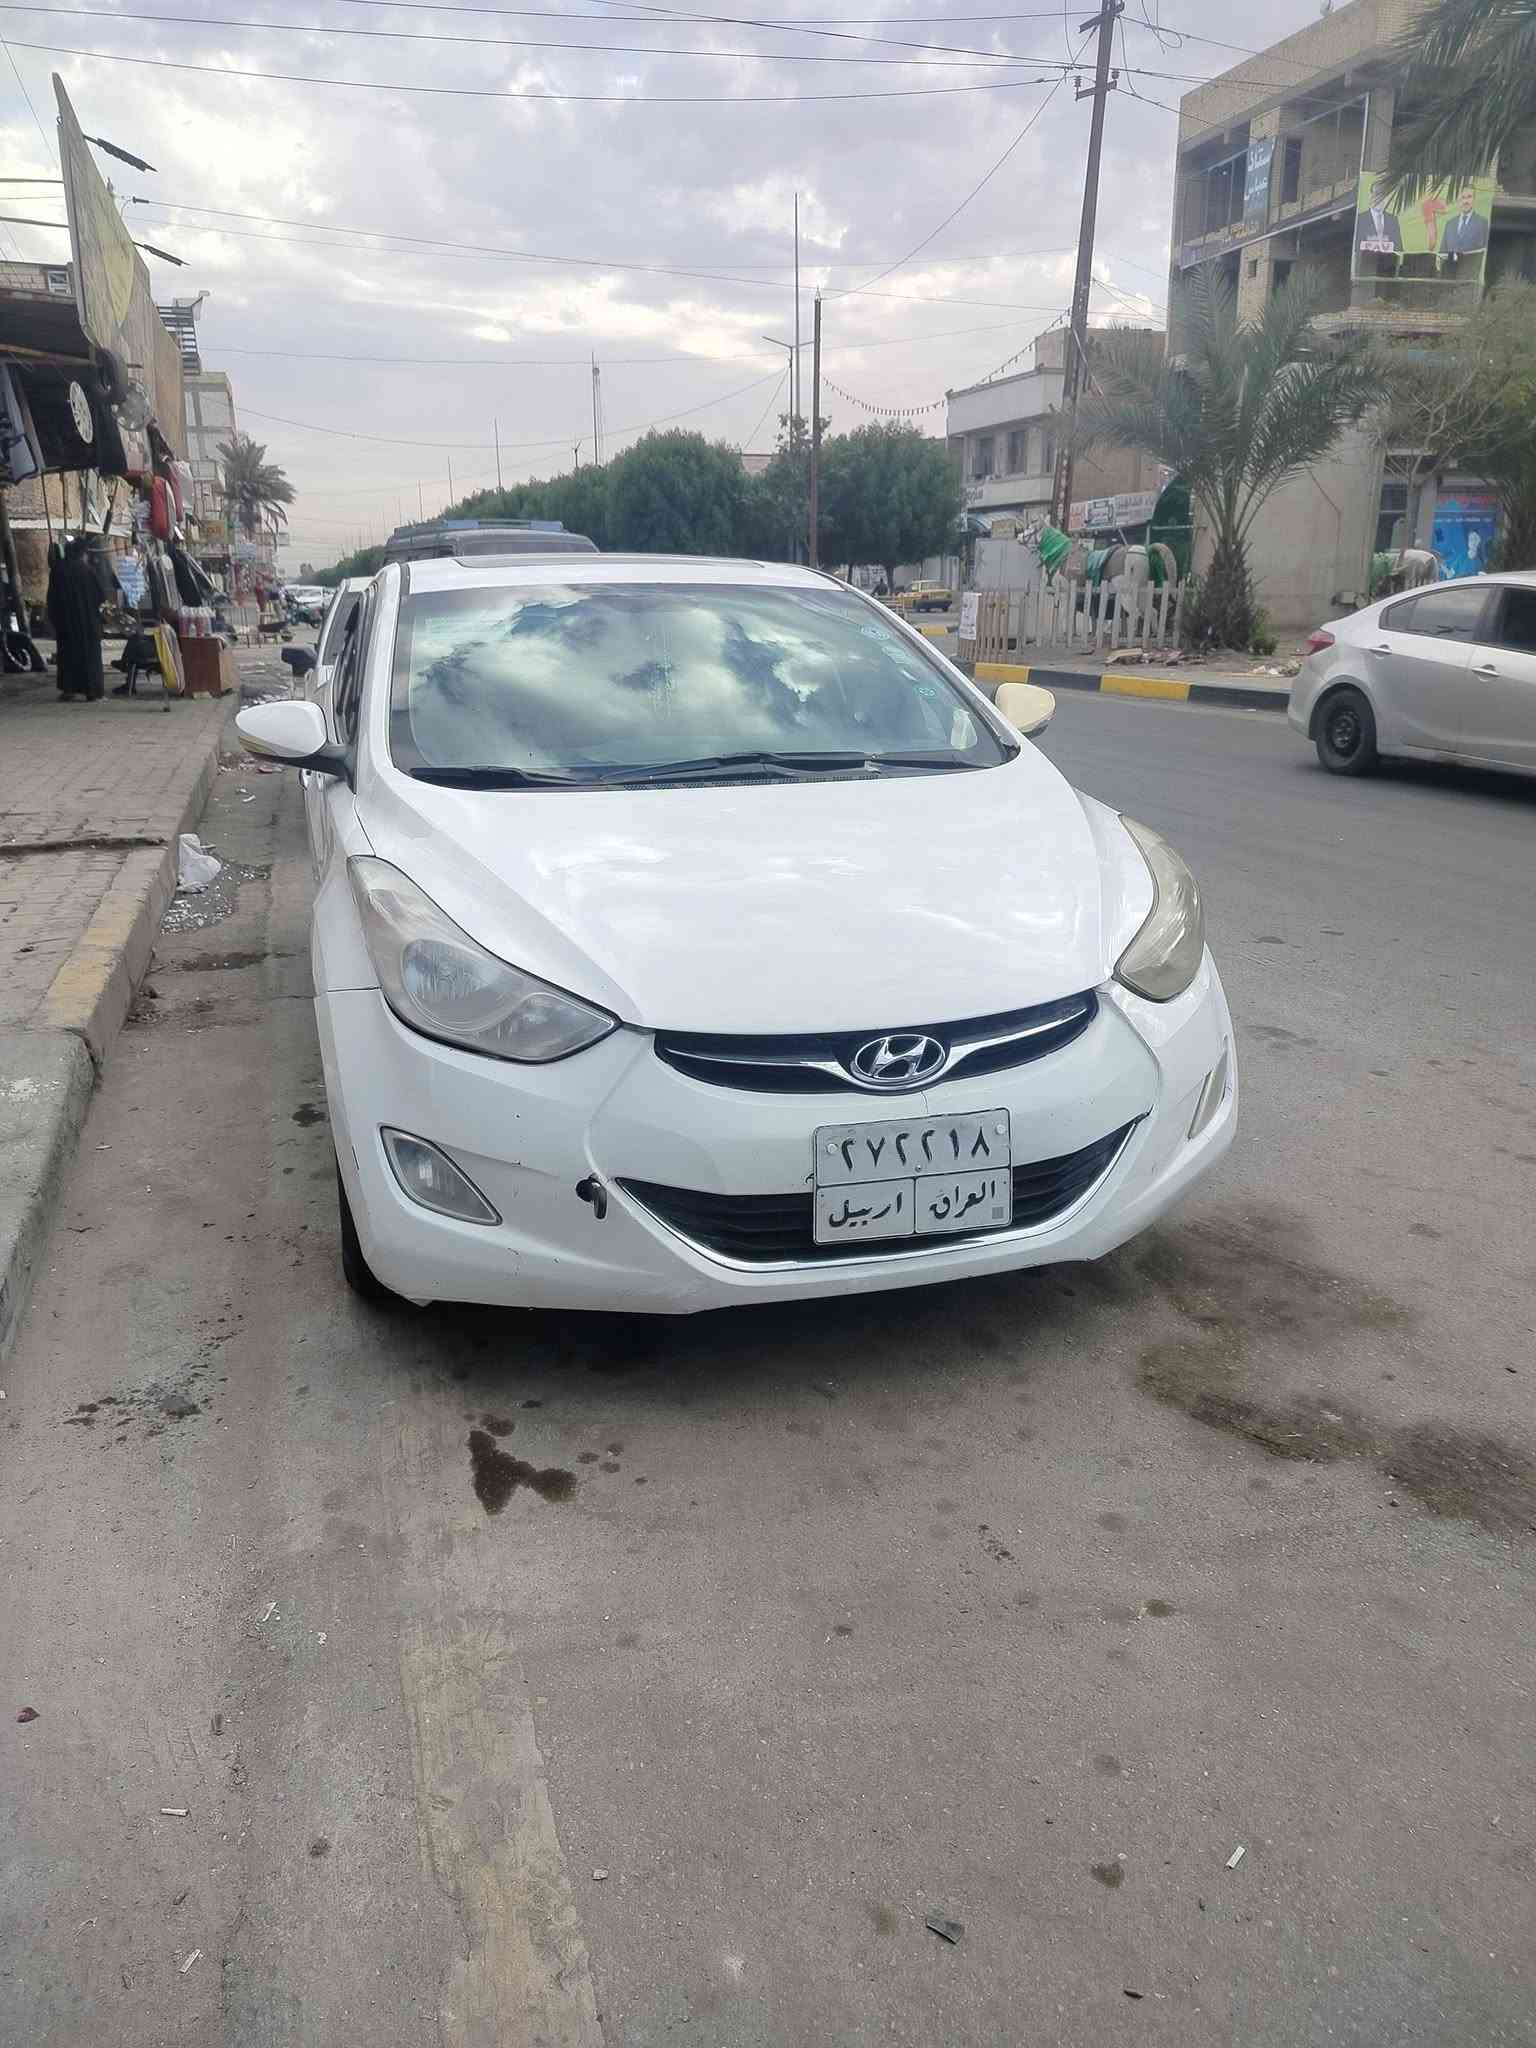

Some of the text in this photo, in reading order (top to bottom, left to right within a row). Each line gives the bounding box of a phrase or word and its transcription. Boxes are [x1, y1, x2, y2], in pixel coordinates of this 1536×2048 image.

[841, 1126, 991, 1172] ٢٧٢٢١٨
[828, 1191, 903, 1227] اربيل
[929, 1180, 996, 1220] العراق
